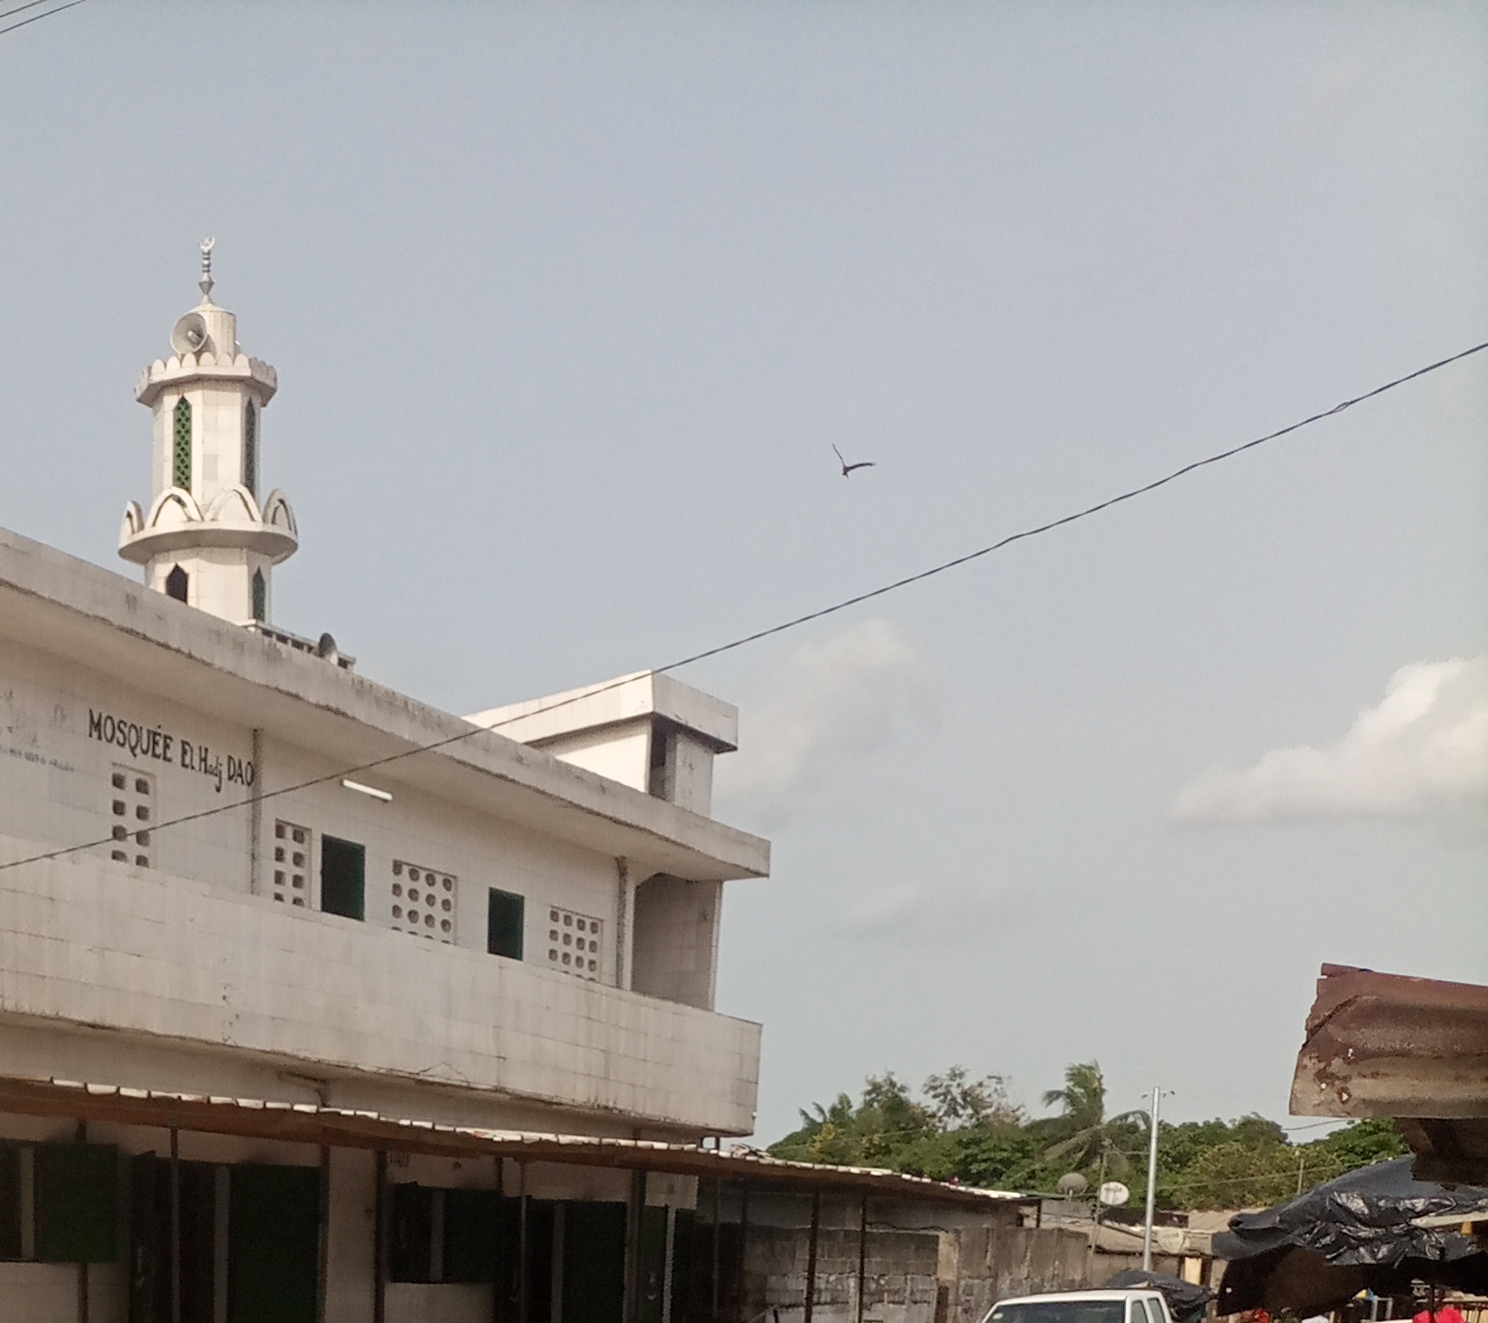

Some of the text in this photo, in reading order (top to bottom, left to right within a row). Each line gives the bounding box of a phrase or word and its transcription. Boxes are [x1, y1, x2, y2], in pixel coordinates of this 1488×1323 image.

[89, 709, 173, 763] MOSQUÉE
[198, 746, 222, 793] Hadj
[228, 755, 254, 787] DAO
